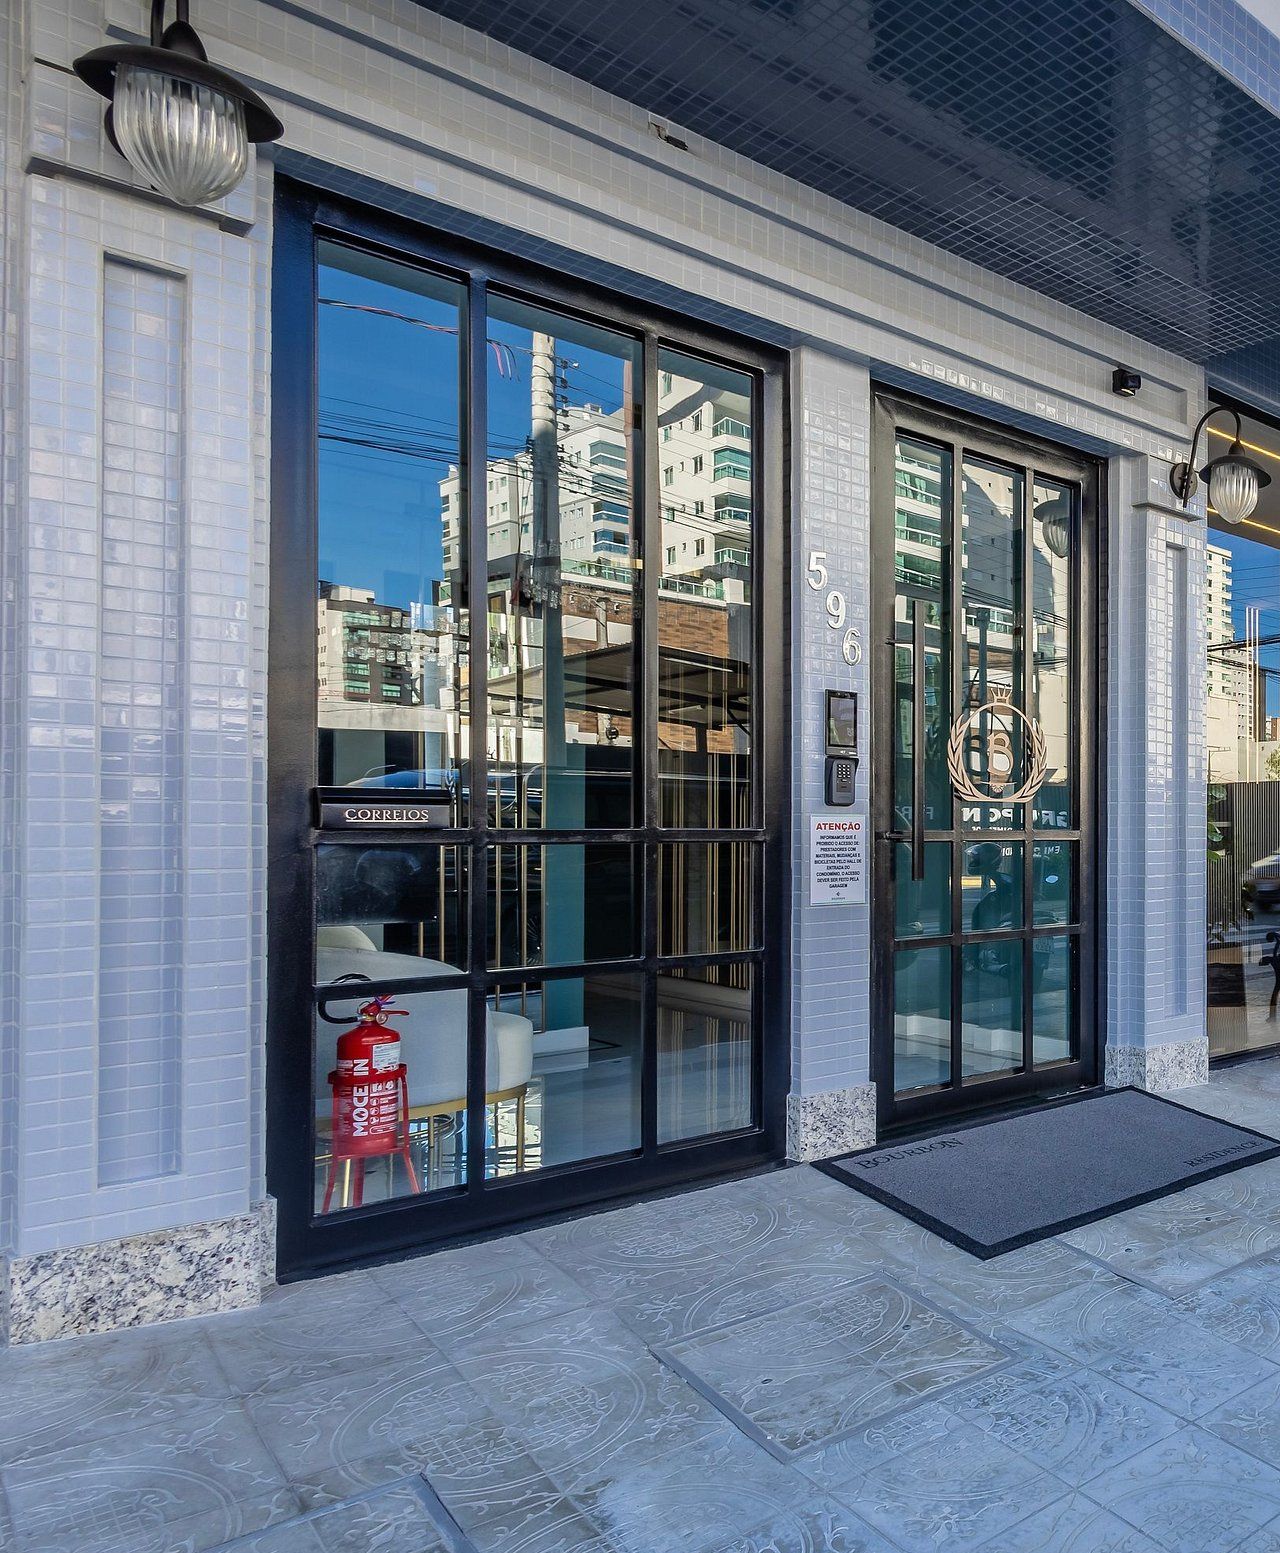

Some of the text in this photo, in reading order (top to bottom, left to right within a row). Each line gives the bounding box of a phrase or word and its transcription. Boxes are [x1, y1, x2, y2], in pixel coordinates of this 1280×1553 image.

[345, 808, 429, 821] CORREIOS
[816, 821, 861, 832] ATENÇÃO
[854, 1137, 964, 1169] BOURBON
[1182, 1141, 1263, 1168] RESIDENCE
